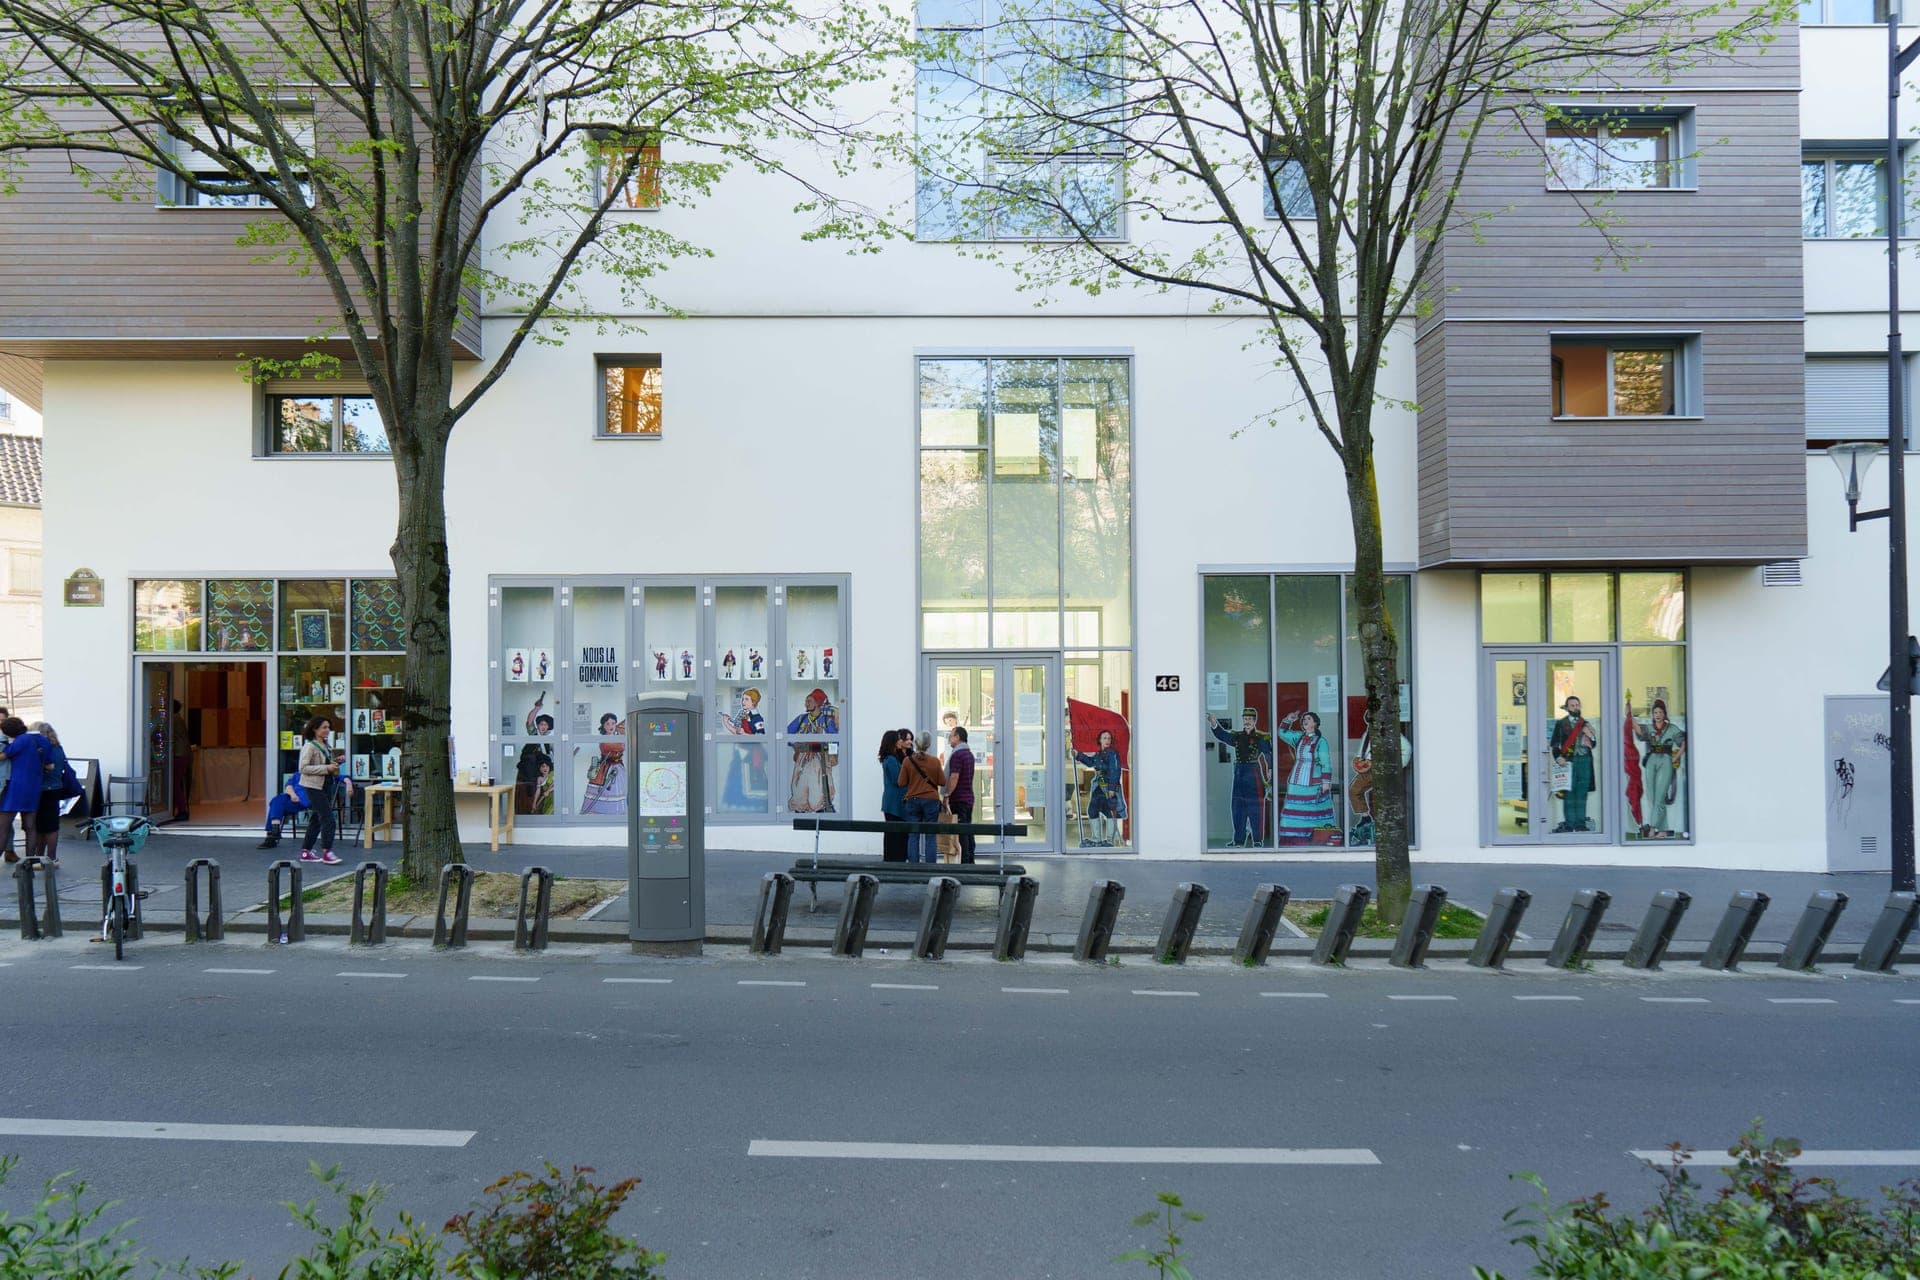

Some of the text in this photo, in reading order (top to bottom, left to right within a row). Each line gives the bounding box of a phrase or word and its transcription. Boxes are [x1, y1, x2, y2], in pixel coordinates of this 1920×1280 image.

[583, 647, 615, 663] NOUS LA
[579, 666, 619, 682] COMMUNE
[1157, 677, 1178, 690] 46
